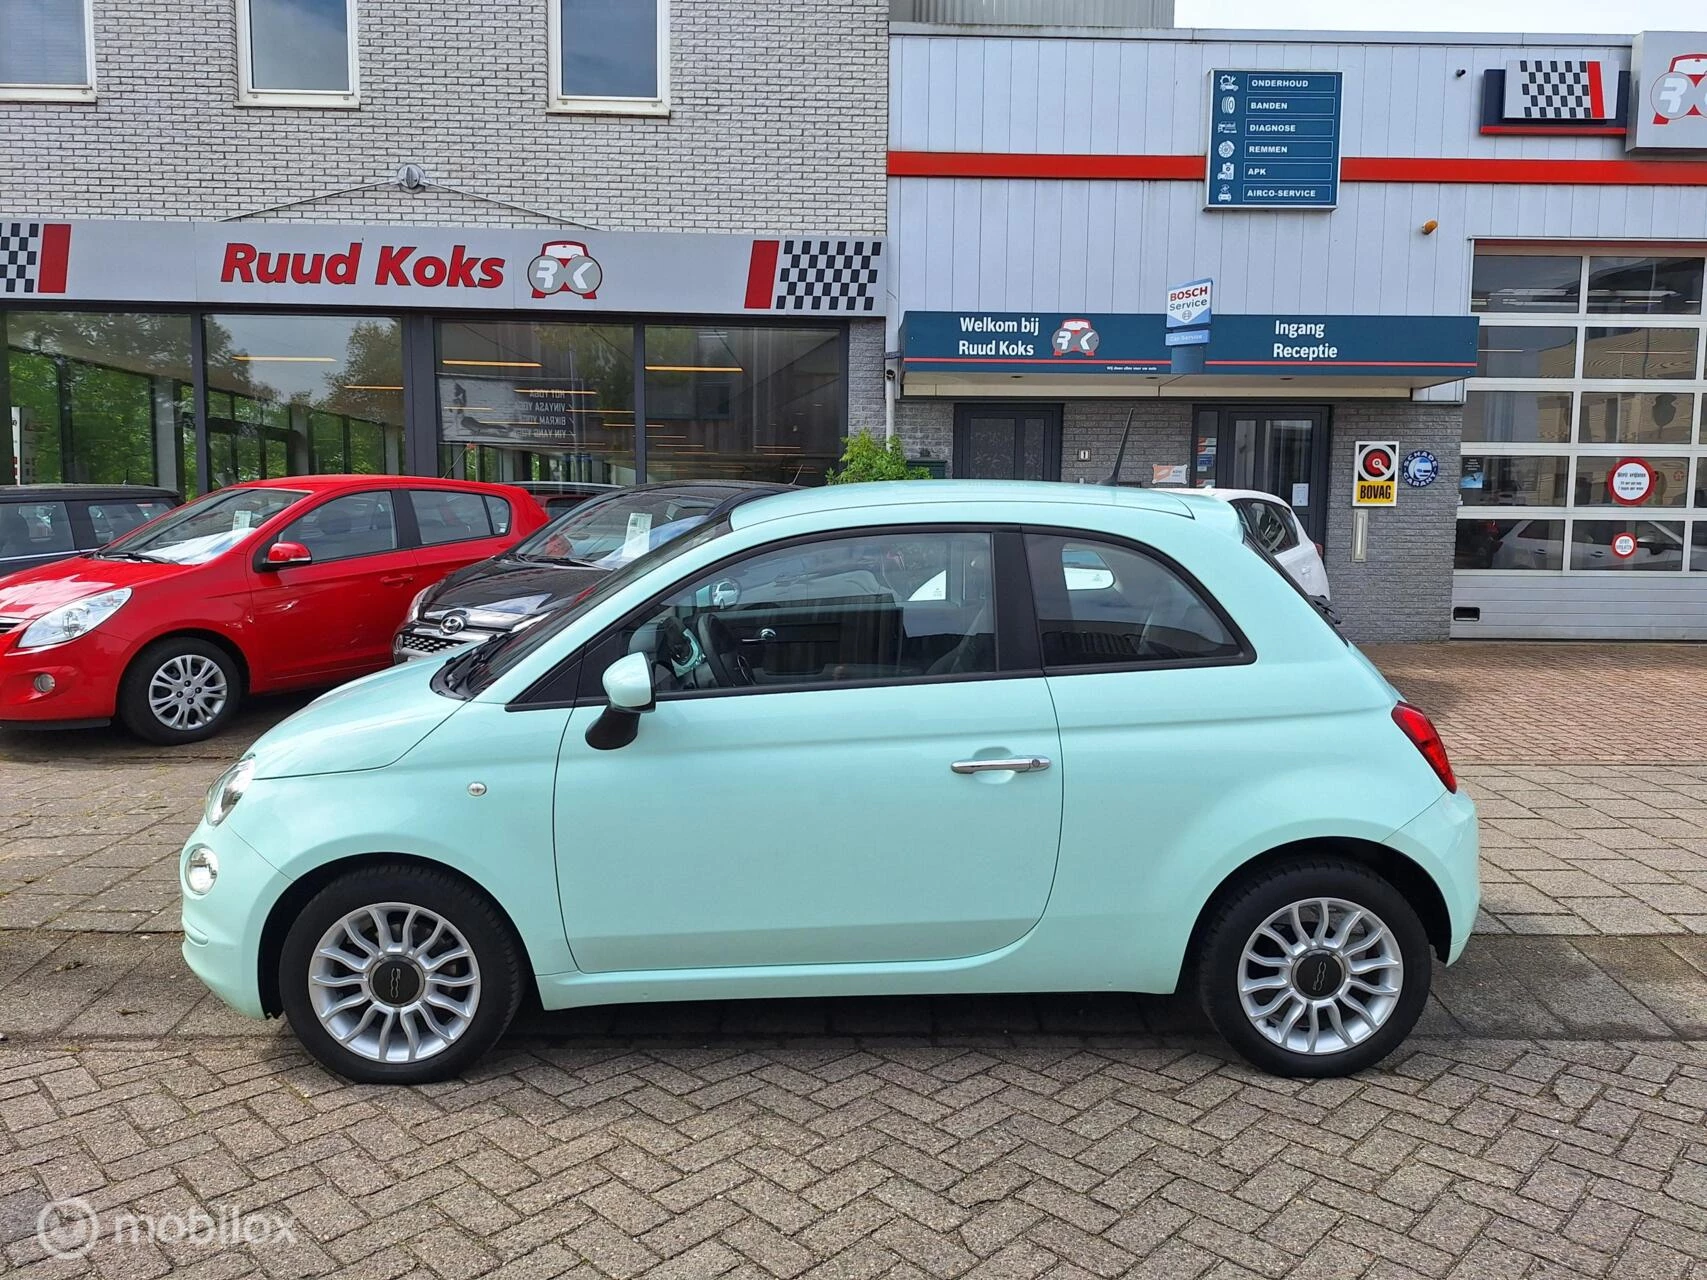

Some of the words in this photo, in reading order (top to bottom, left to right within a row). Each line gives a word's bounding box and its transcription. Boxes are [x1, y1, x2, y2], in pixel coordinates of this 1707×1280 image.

[1251, 79, 1309, 88] ONDERHOUD
[1250, 101, 1288, 110] BANDEN
[1249, 123, 1296, 133] DIAGNOSE
[1248, 145, 1288, 154] REMMEN
[1247, 167, 1267, 176] APK
[1246, 188, 1317, 198] AIRCO-SERVICE
[220, 242, 362, 286] Ruud
[374, 245, 505, 289] Koks
[1169, 286, 1208, 302] BOSCH
[1169, 298, 1208, 312] Service
[960, 317, 1018, 333] Welkom
[1021, 318, 1040, 336] bij
[1275, 320, 1325, 338] Ingang
[959, 340, 996, 356] Ruud
[999, 340, 1035, 356] Koks
[1273, 343, 1338, 361] Receptie
[1403, 451, 1438, 467] SCHADE
[1360, 484, 1391, 500] BOVAG
